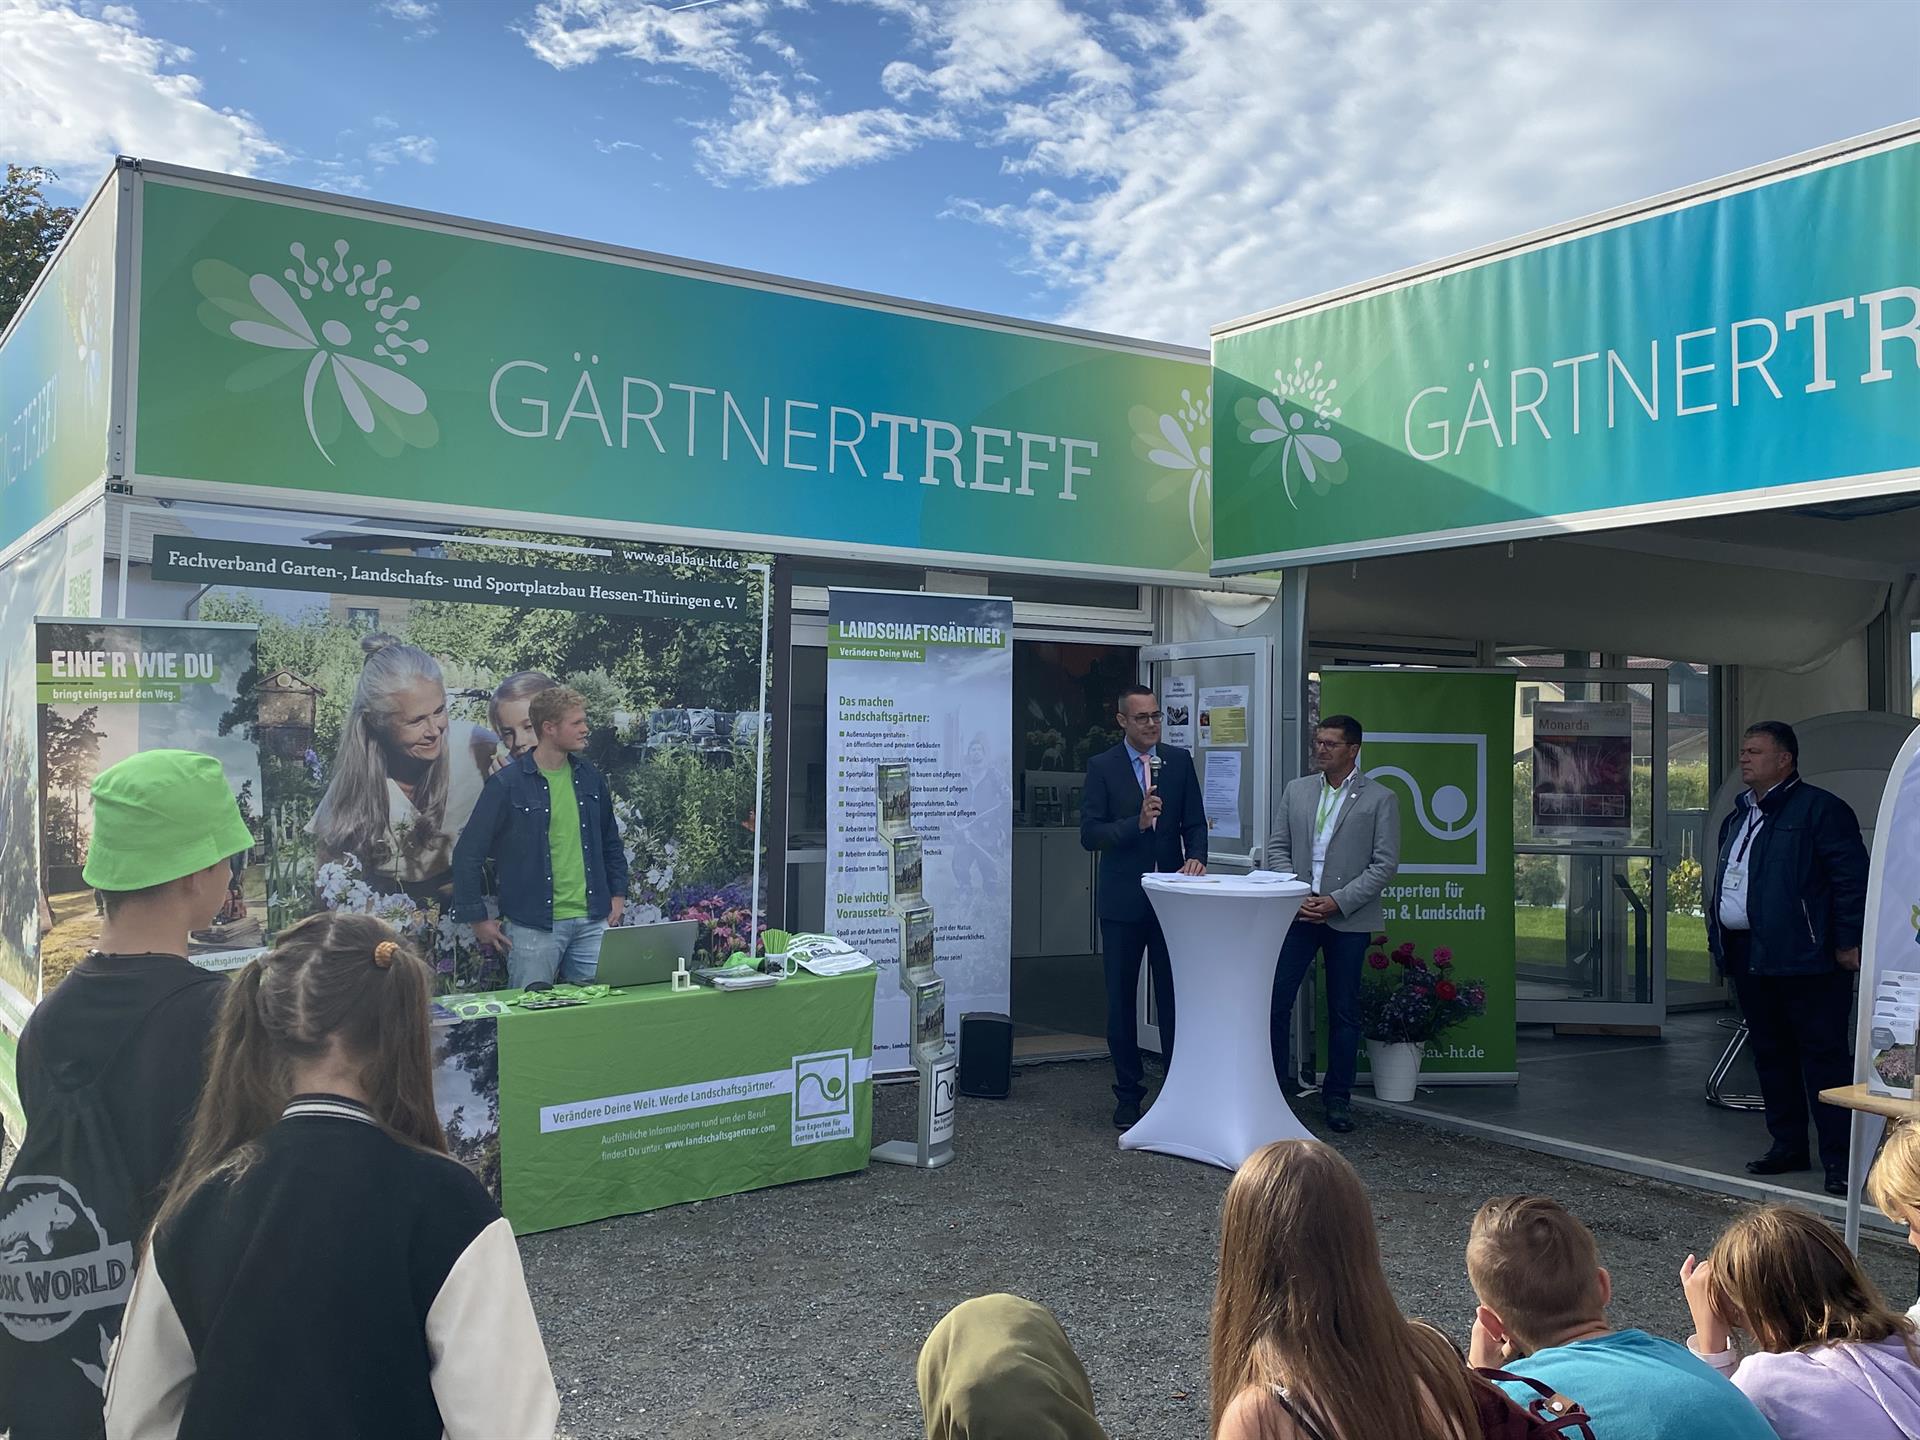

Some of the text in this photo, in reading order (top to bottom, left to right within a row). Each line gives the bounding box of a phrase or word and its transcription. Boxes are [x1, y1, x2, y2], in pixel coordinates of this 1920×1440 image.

[488, 351, 1099, 501] GÄRTNERTREFF
[623, 550, 739, 569] www.galabau-ht.de
[168, 550, 277, 574] Fachverband
[281, 560, 347, 582] Garten-,
[351, 566, 449, 587] Landschafts-
[454, 576, 482, 589] und
[486, 577, 586, 598] Sportplatzbau
[590, 585, 711, 609] Hessen-Thüringen
[839, 620, 1001, 644] LANDSCHAFTSGÄRTNER
[840, 647, 921, 659] Verändere Deine Welt.
[133, 652, 177, 678] WIE
[184, 653, 213, 678] DU
[53, 688, 176, 701] bringt einiges auf den Weg.
[839, 696, 894, 707] Das machen
[839, 711, 930, 724] Landschaftsgärtner:
[1538, 719, 1590, 731] Monarda
[846, 731, 882, 739] Außenanlagen
[895, 741, 914, 749] privaten
[915, 741, 941, 749] Gebäuden
[846, 771, 874, 779] Sportplätze
[943, 771, 961, 779] pflegen
[949, 785, 968, 793] pflegen
[845, 811, 876, 819] begrünunge
[1445, 881, 1464, 898] für
[837, 892, 889, 905] Die wichtig
[836, 907, 888, 919] Voraussetz
[1401, 904, 1411, 920] &
[1415, 903, 1486, 920] Landschaft
[837, 929, 849, 937] Spaß
[553, 1080, 775, 1123] Verändere Deine Welt. Werde Landschaftsgärtner.
[601, 1108, 766, 1145] Ausführliche Informationen rund um den Beruf
[807, 1121, 831, 1131] Experten
[601, 1149, 627, 1161] findest
[628, 1146, 640, 1156] Du
[665, 1124, 775, 1150] www.landschaftsgaertner.com
[25, 1260, 126, 1304] WORLD
